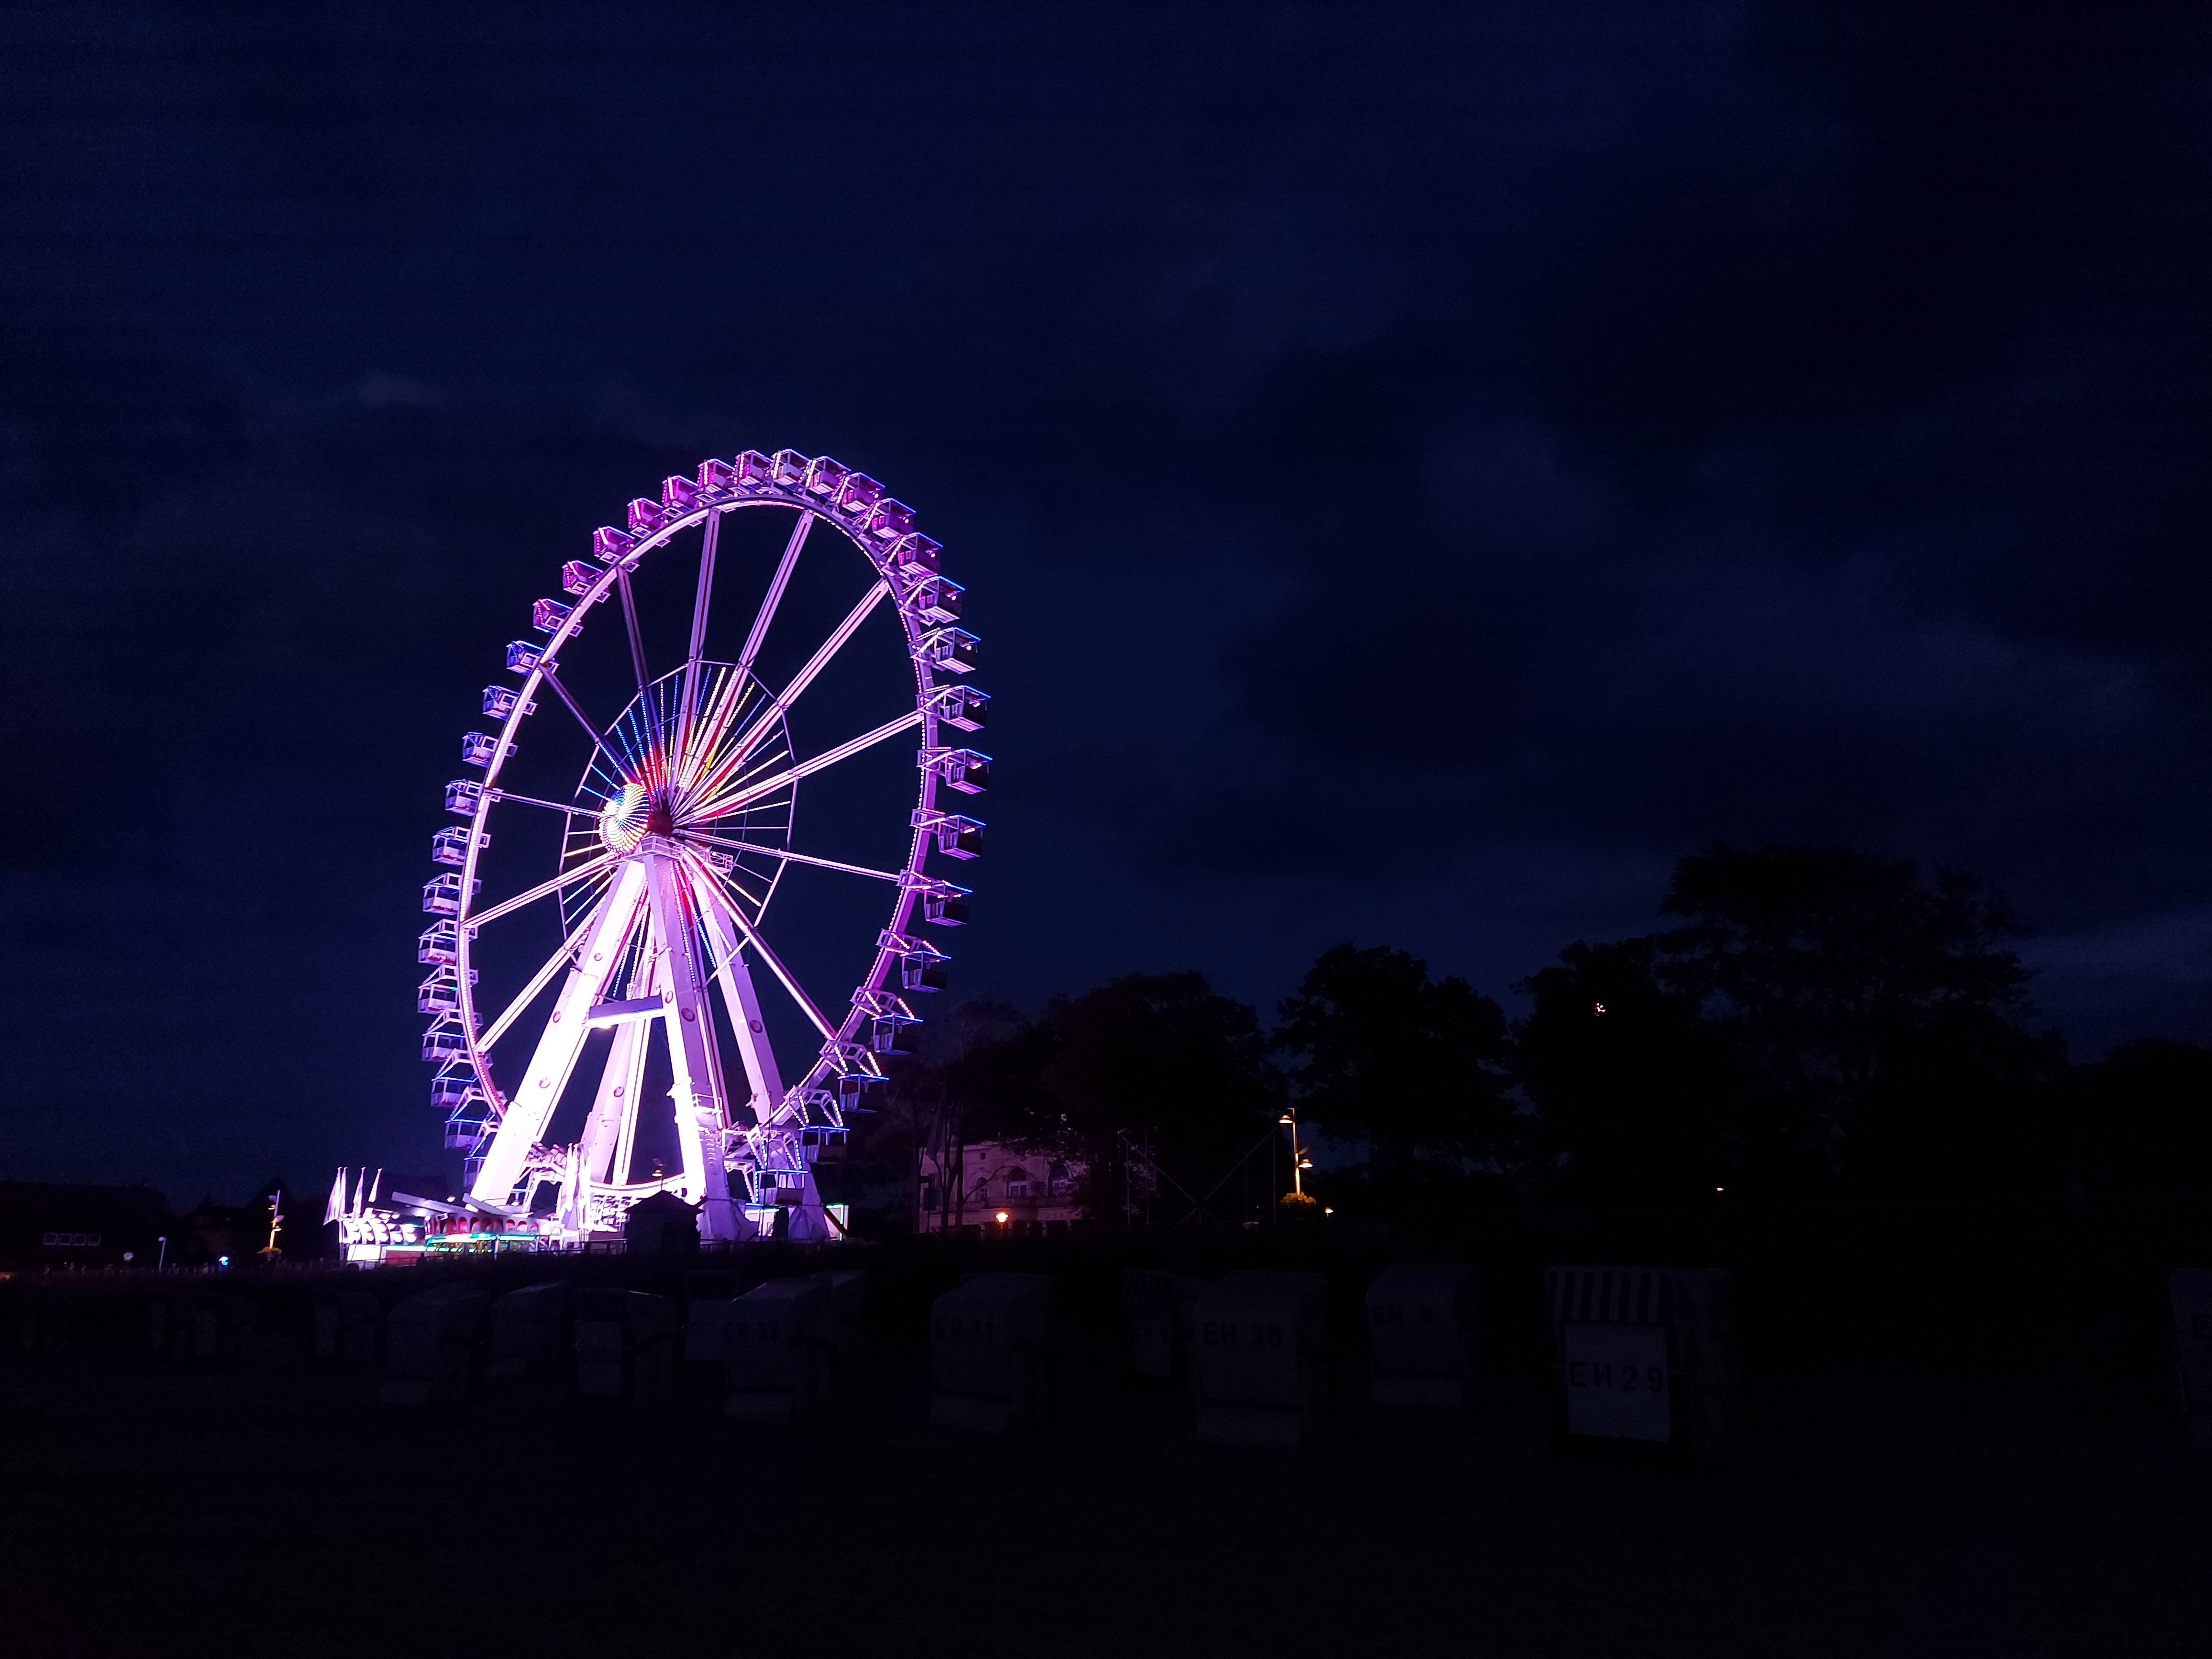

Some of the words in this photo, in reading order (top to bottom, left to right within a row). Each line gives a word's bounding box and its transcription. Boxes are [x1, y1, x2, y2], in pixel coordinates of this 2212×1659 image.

[724, 1321, 748, 1341] EH
[757, 1320, 779, 1341] 32
[935, 1316, 962, 1339] EH
[971, 1319, 994, 1342] 31
[1204, 1321, 1238, 1347] EH
[1250, 1323, 1283, 1349] 30
[1570, 1361, 1613, 1388] EH
[1621, 1365, 1664, 1394] 29
